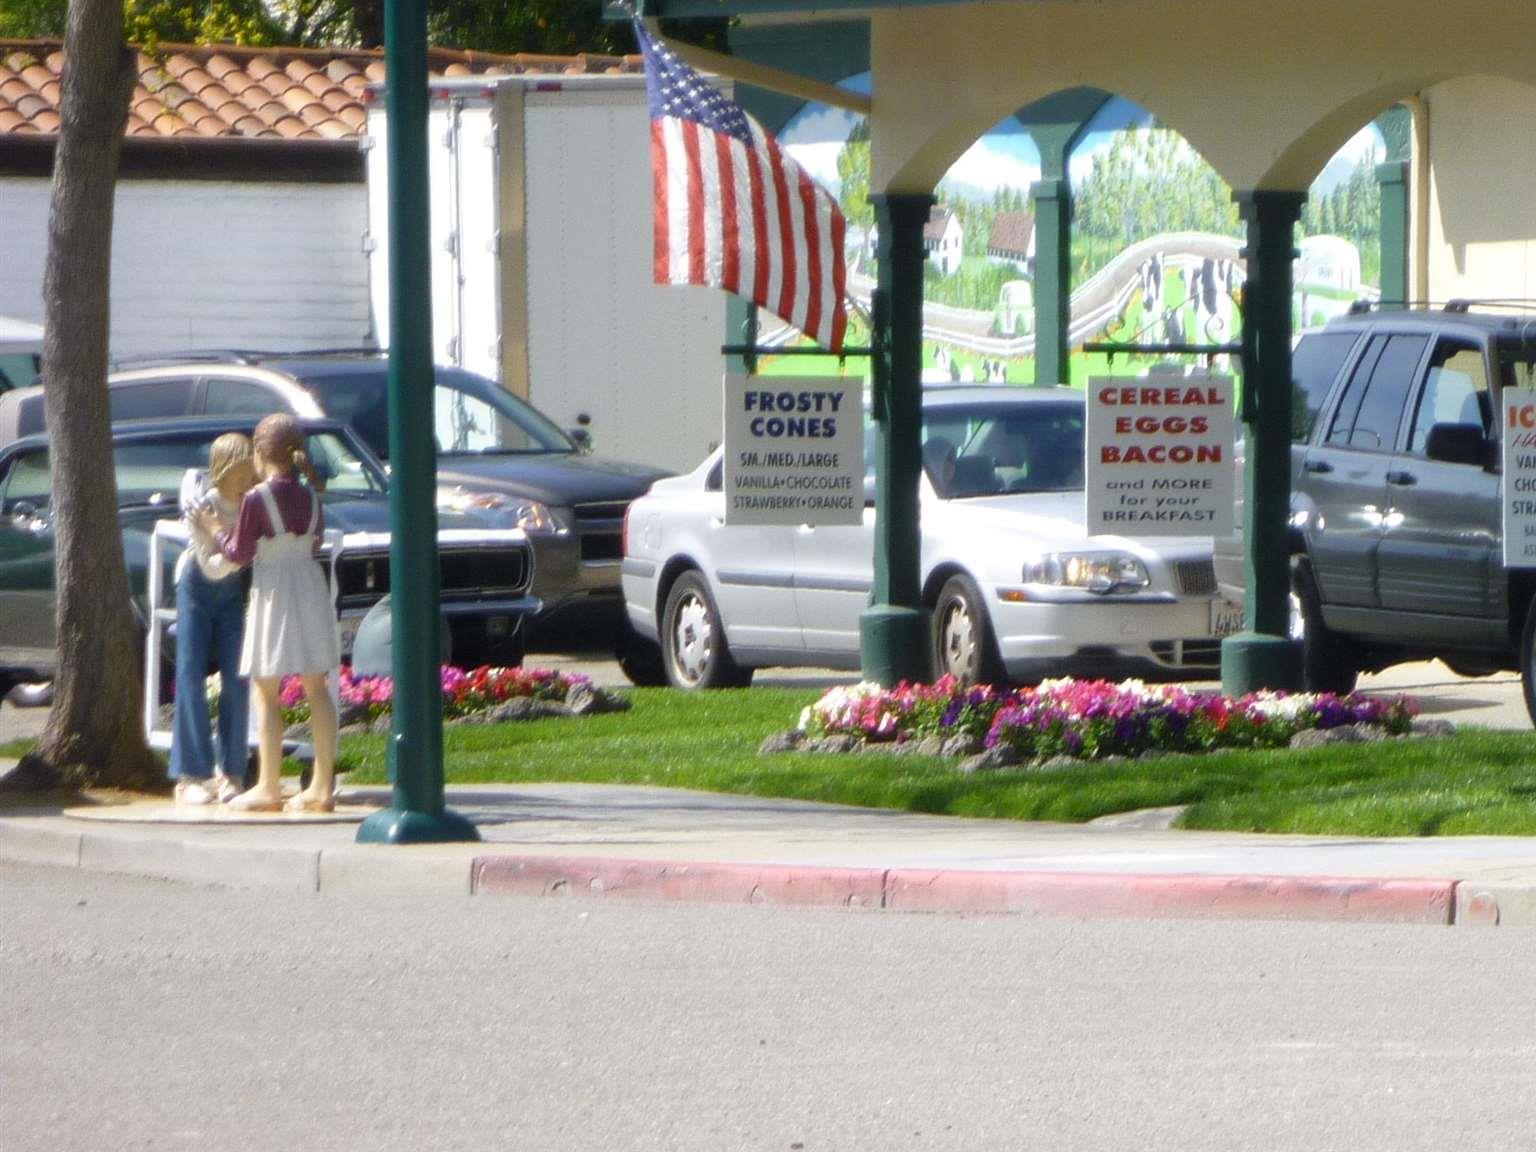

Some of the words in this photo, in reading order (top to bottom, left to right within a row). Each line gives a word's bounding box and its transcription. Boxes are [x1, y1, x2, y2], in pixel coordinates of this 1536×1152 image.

[744, 391, 844, 412] FROSTY
[1099, 387, 1225, 405] CEREAL
[750, 417, 837, 438] CONES
[1115, 416, 1209, 434] EGGS
[1101, 445, 1222, 464] BACON
[1106, 479, 1144, 490] and
[1152, 479, 1214, 490] MORE
[1120, 495, 1148, 506] for
[1156, 496, 1200, 507] your
[1102, 510, 1216, 522] BREAKFAST
